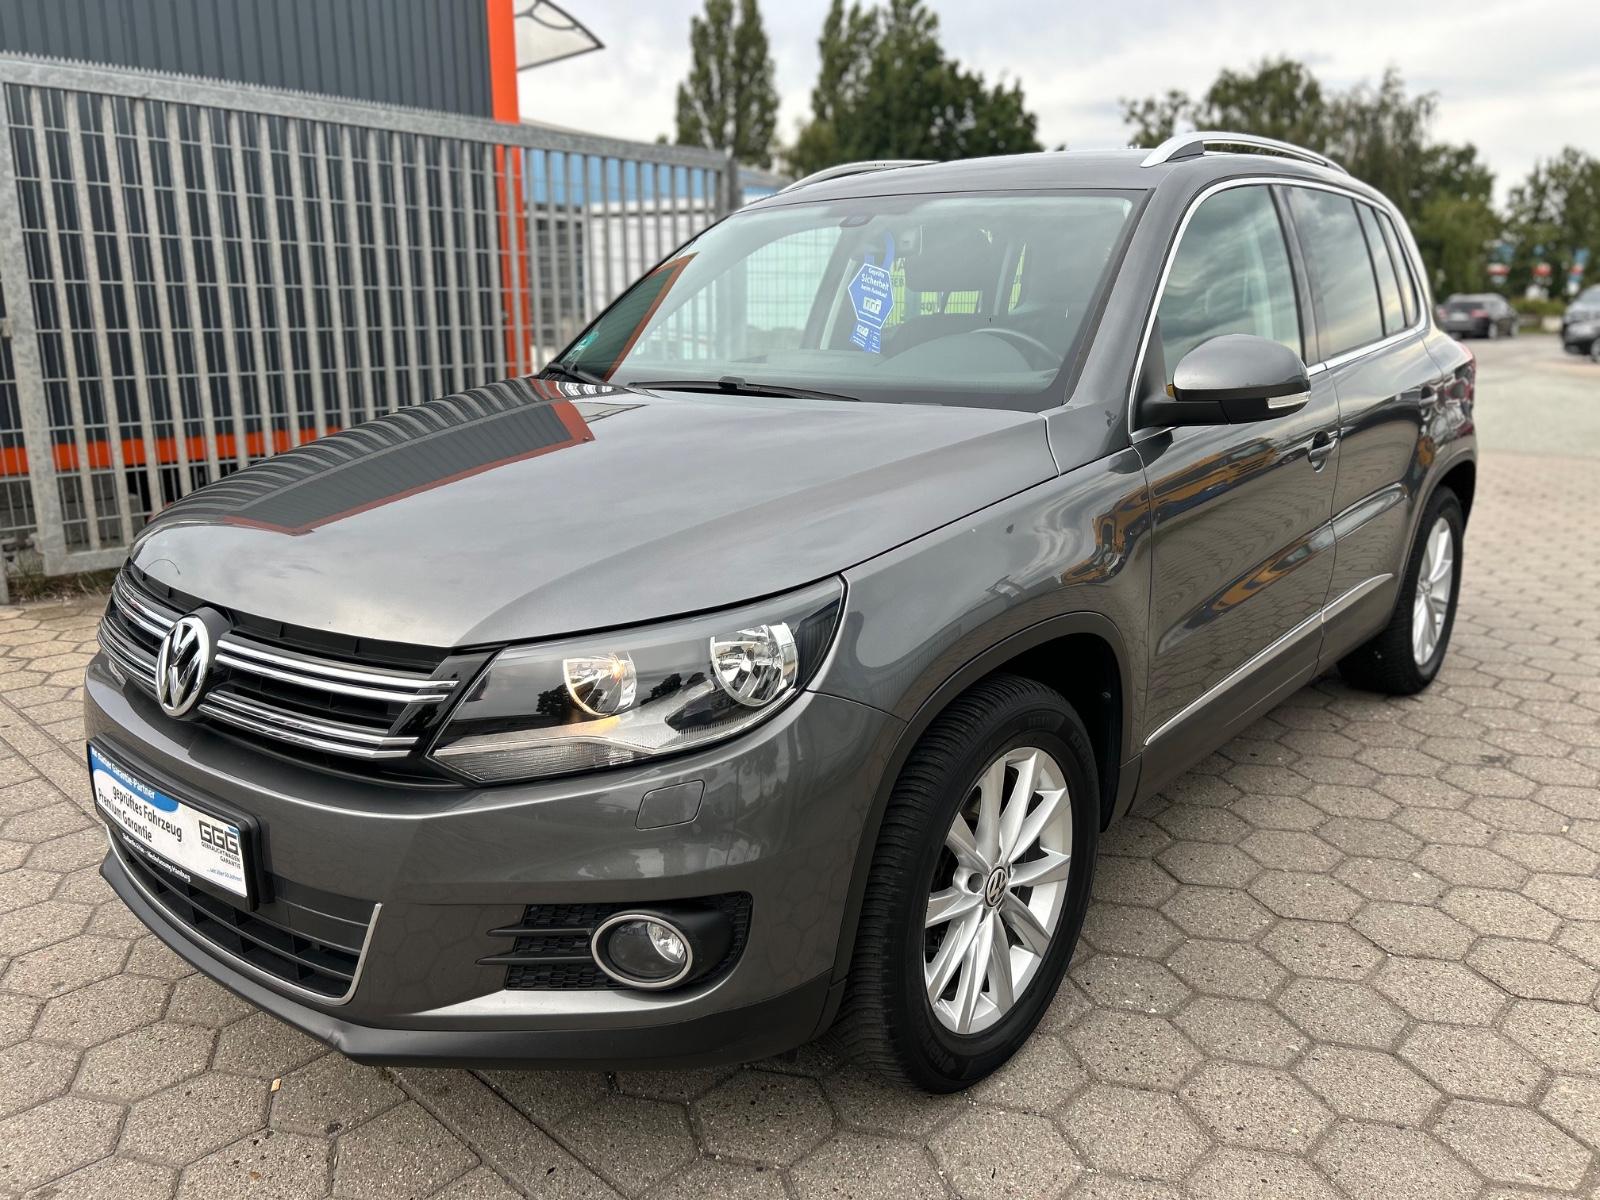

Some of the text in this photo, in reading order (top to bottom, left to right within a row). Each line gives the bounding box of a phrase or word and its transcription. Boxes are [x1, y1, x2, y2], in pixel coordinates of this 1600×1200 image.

[861, 274, 889, 291] Sicherheit
[98, 787, 122, 820] Premium
[122, 811, 153, 843] Garantie
[112, 786, 143, 815] geprüftes
[143, 808, 182, 843] Fahrzeug
[199, 820, 239, 856] GGG
[201, 841, 241, 863] GEBRAUCHTWAGEN
[219, 855, 241, 870] GARANTIE
